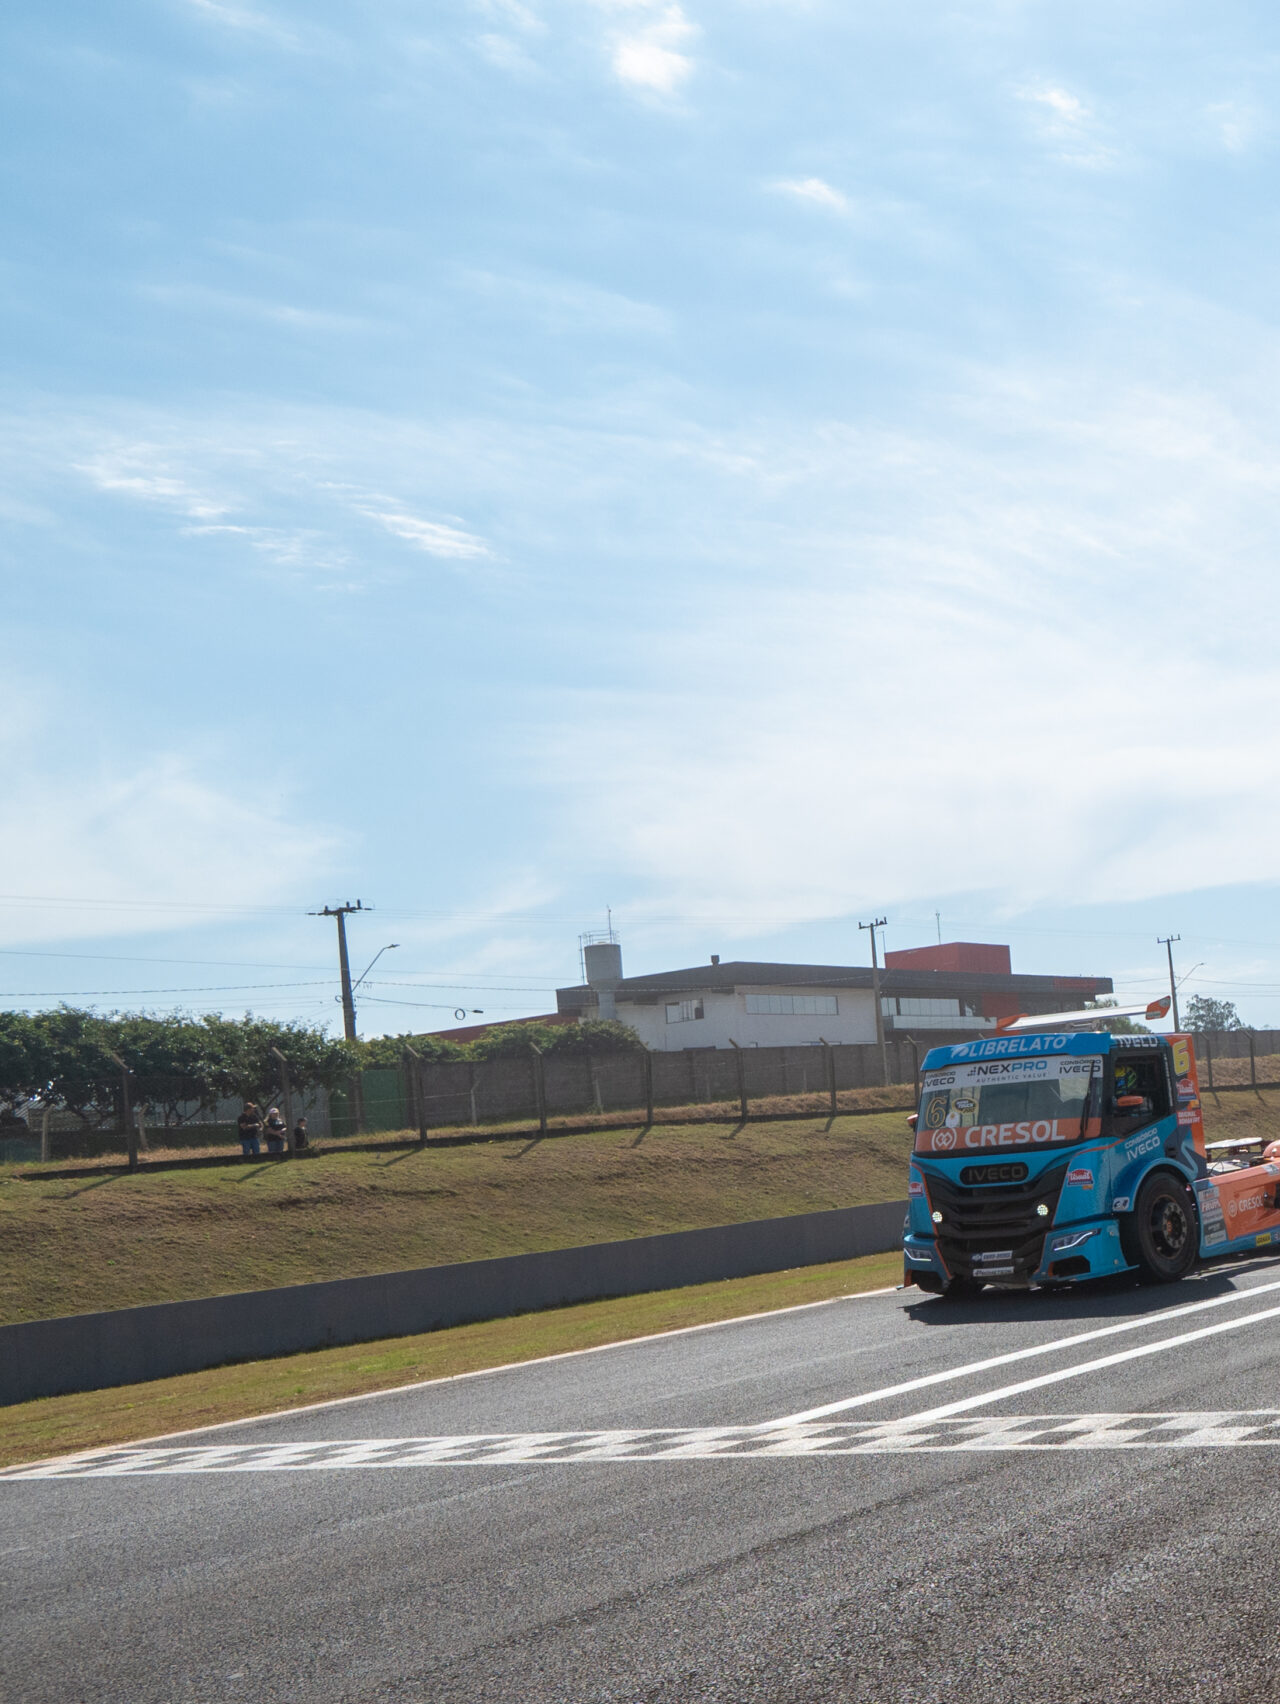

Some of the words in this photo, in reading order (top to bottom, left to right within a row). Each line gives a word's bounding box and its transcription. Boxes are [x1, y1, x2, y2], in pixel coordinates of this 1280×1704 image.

[968, 1036, 1067, 1057] LIBRELATO
[977, 1060, 1048, 1076] NEXPRO
[1172, 1040, 1191, 1076] 6
[976, 1074, 1020, 1083] AUTHENTIC
[925, 1097, 947, 1129] 6
[965, 1119, 1066, 1148] CRESOL
[1127, 1136, 1160, 1160] IVECO
[968, 1164, 1025, 1182] IVECO
[1238, 1195, 1263, 1212] CRESOL
